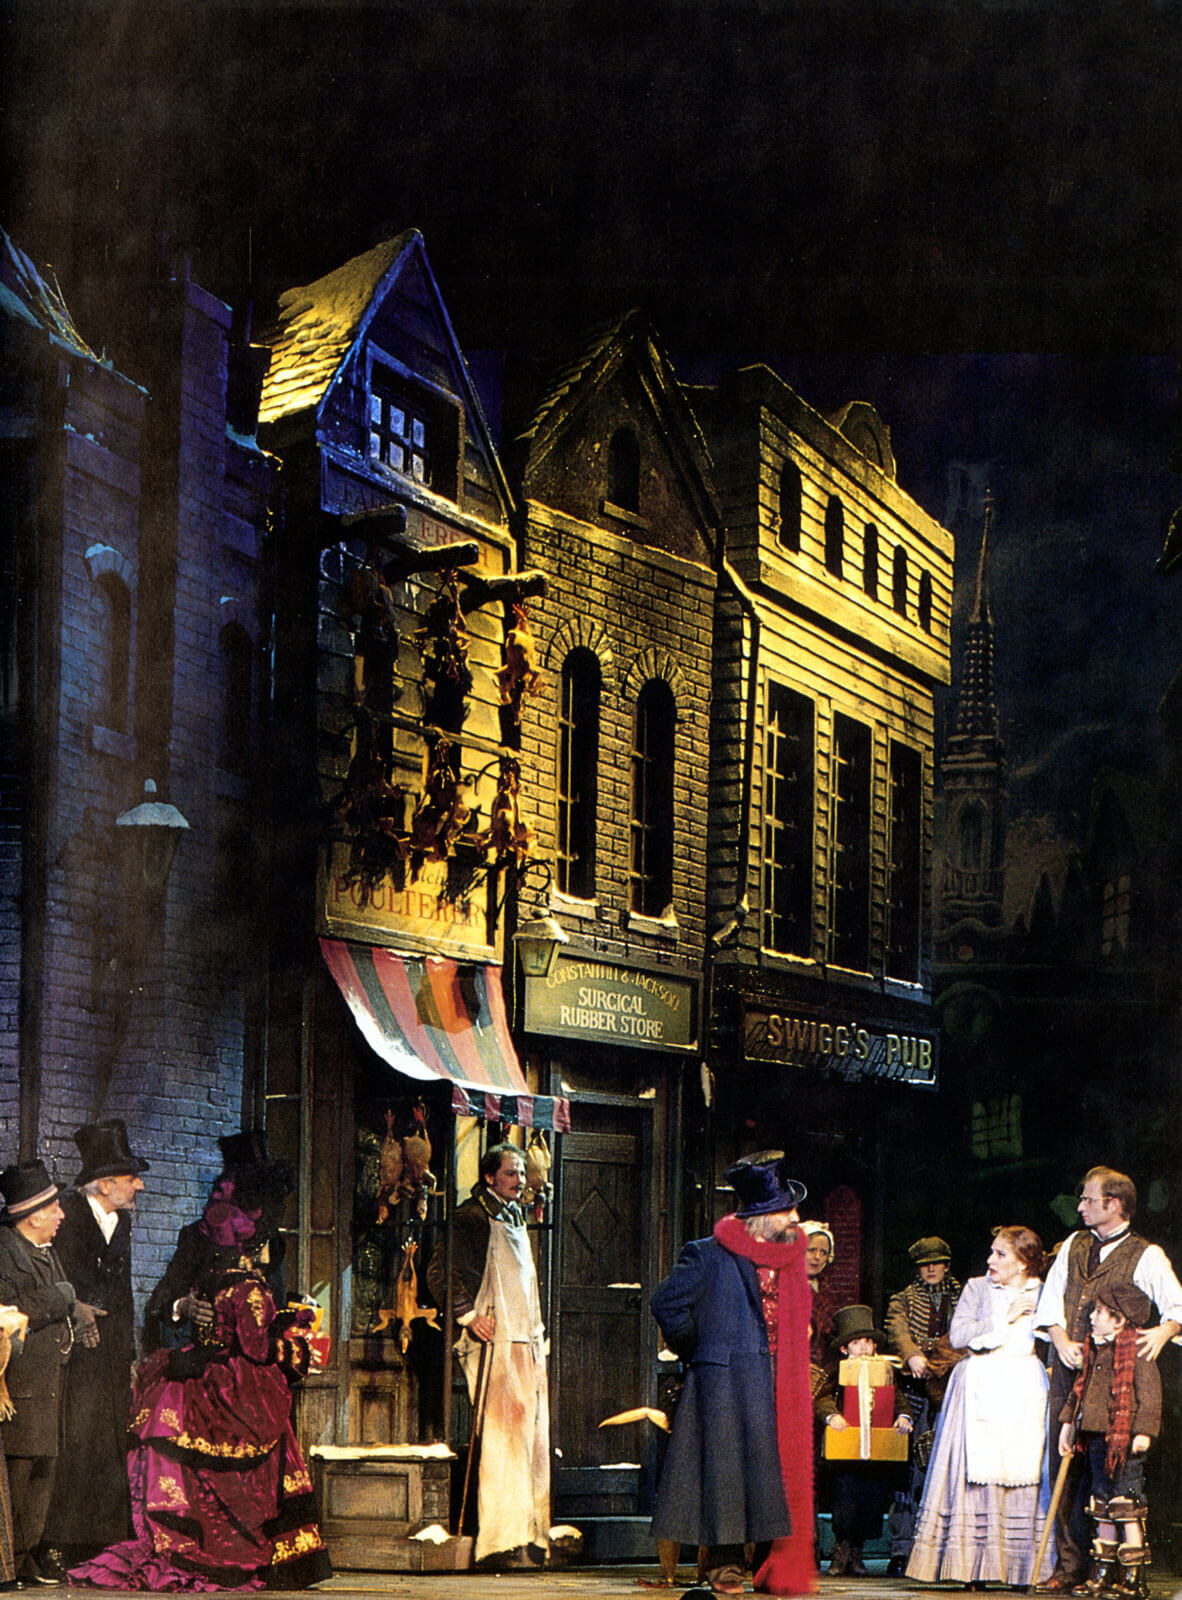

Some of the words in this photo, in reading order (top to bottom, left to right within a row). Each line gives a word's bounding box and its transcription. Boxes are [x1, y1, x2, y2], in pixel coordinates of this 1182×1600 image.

[559, 1005, 617, 1032] RUBBER
[620, 1015, 665, 1039] STORE
[767, 1014, 870, 1060] SWIGG'S
[885, 1034, 932, 1070] PUB
